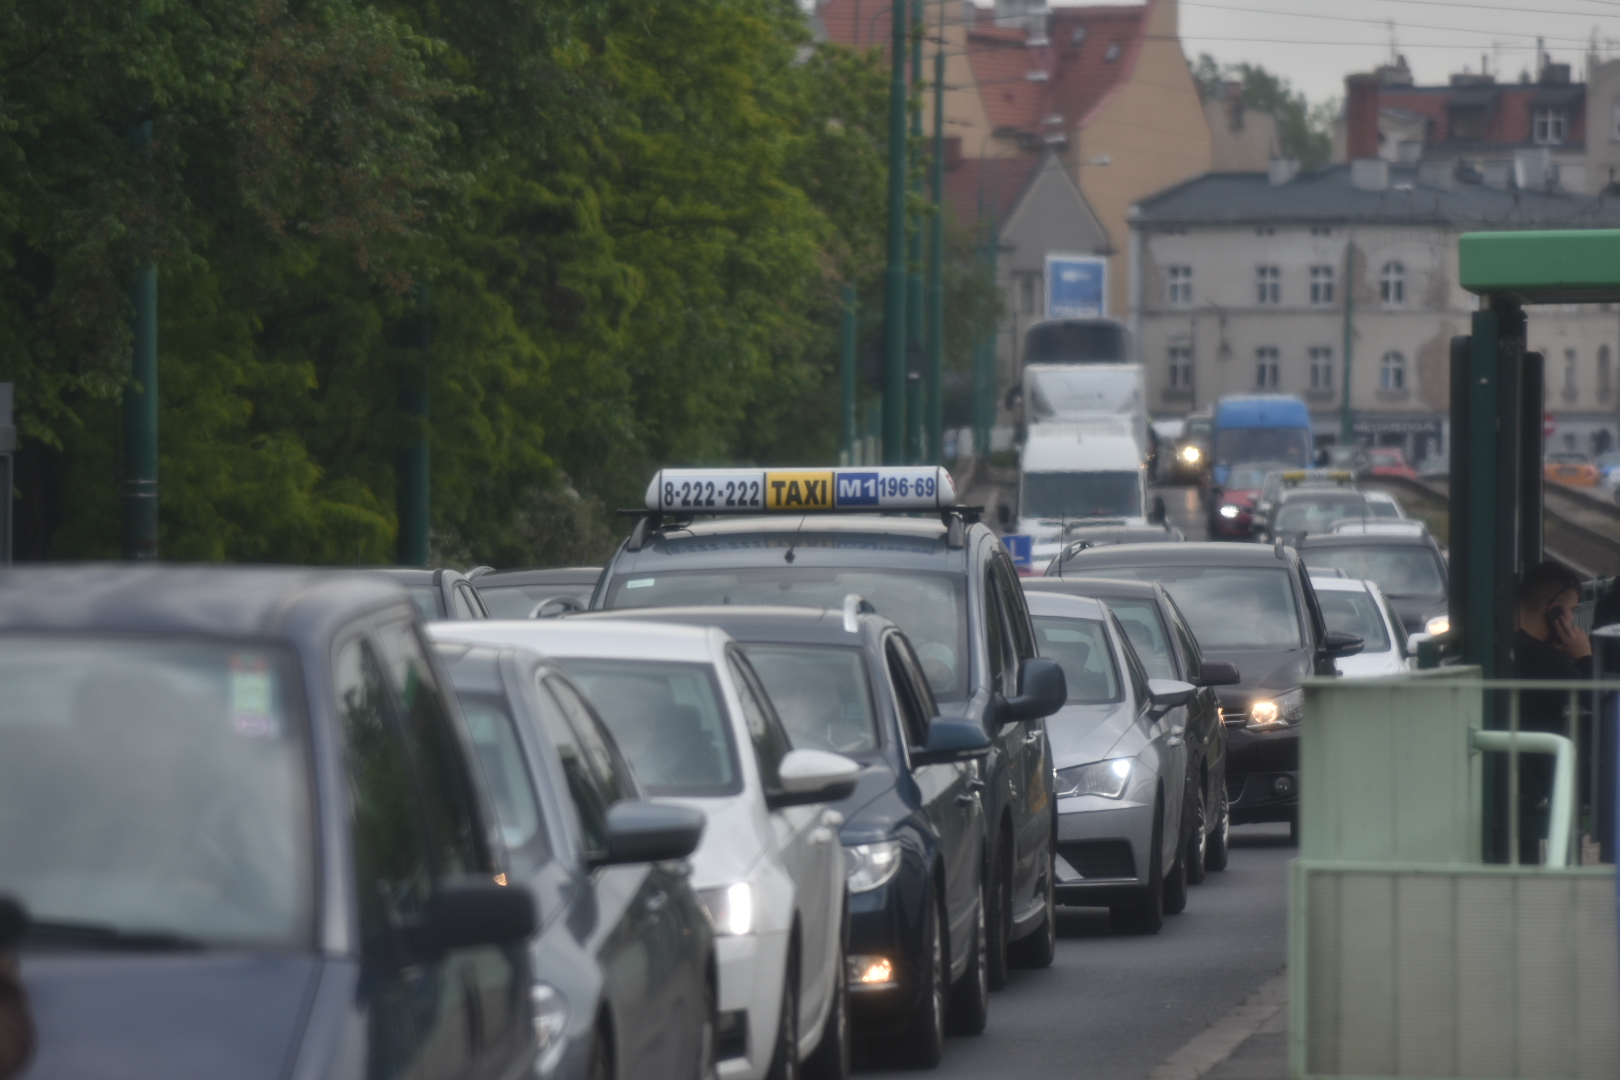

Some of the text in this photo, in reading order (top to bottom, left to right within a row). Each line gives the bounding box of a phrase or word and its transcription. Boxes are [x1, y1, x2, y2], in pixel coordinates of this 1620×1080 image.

[771, 481, 827, 506] TAXI
[879, 477, 935, 498] 196-69
[1010, 539, 1024, 560] L
